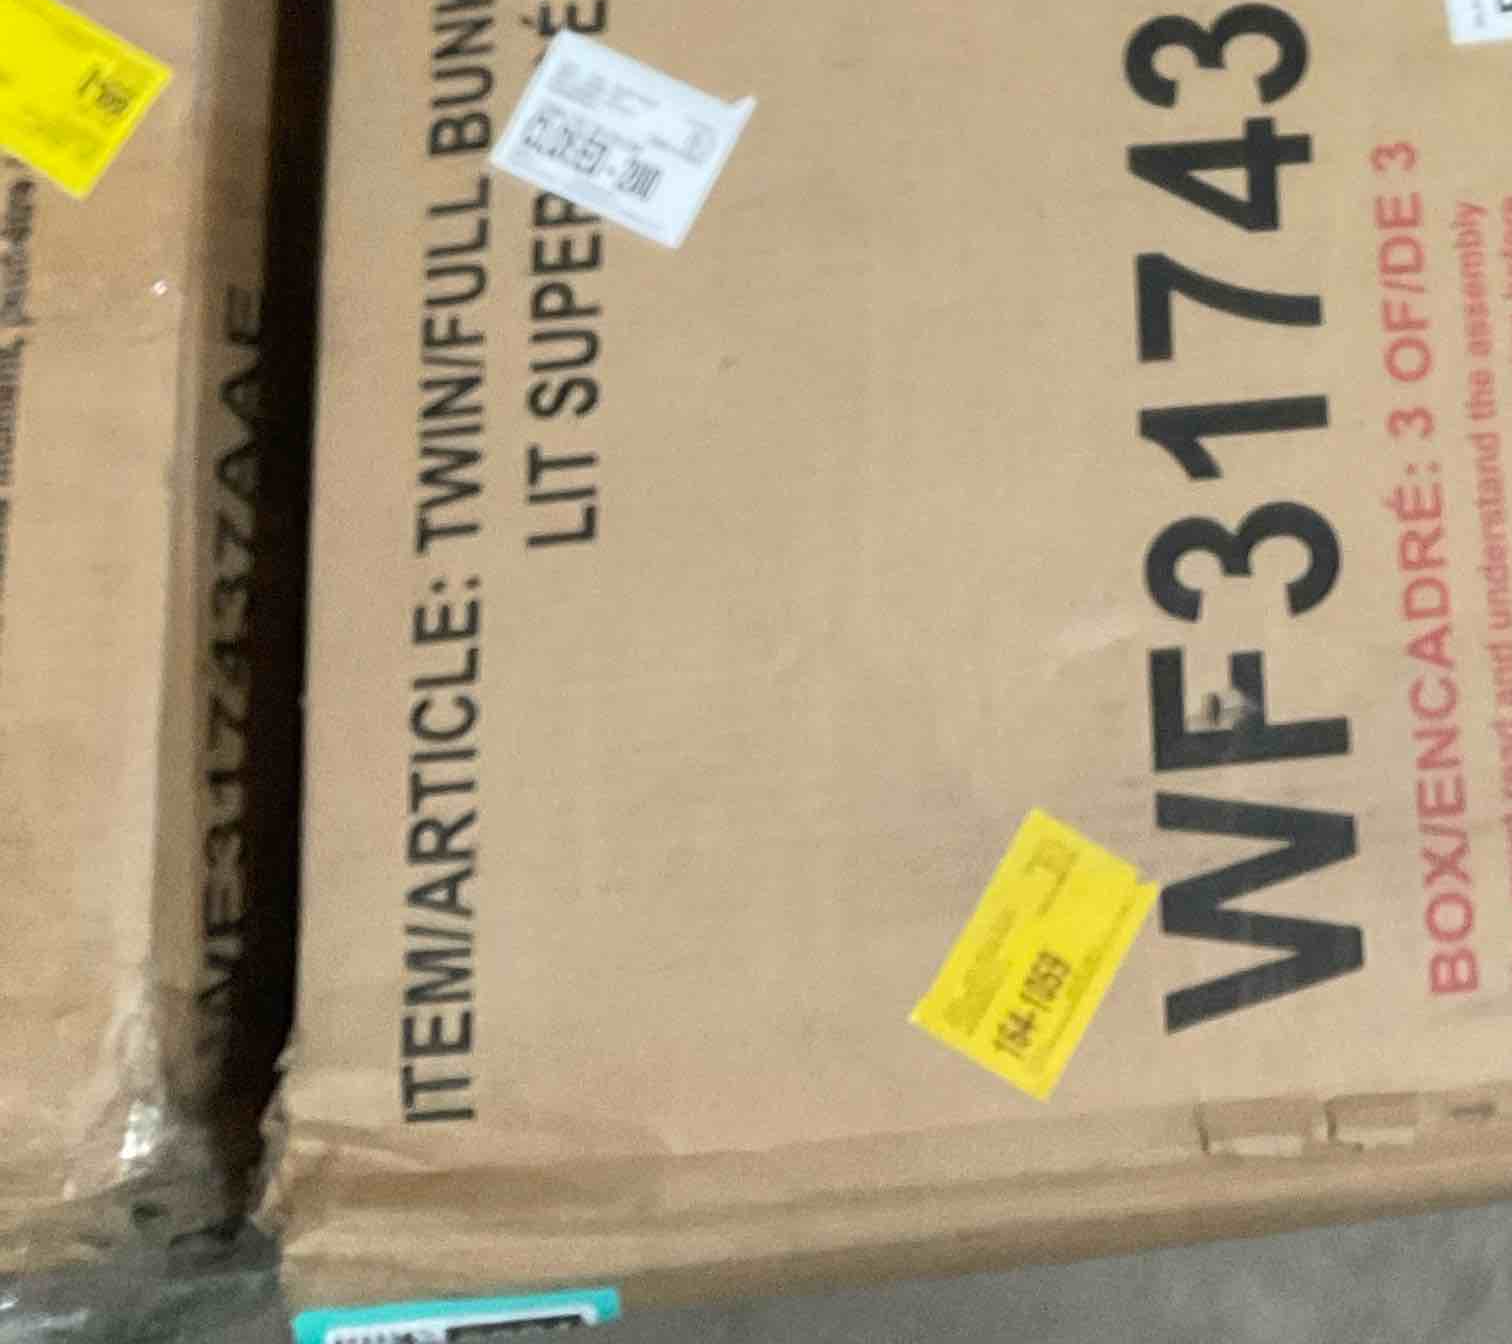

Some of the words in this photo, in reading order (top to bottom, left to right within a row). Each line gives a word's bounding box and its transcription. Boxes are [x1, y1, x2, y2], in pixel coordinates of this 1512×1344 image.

[1368, 141, 1418, 174] 3
[413, 175, 491, 556] TWIN/FULL
[1374, 191, 1434, 384] OF/DE
[525, 447, 599, 549] LIT
[1385, 405, 1436, 440] 3
[1386, 461, 1481, 997] BOX/ENCADRÉ:
[399, 576, 481, 1125] ITEM/ARTICLE:
